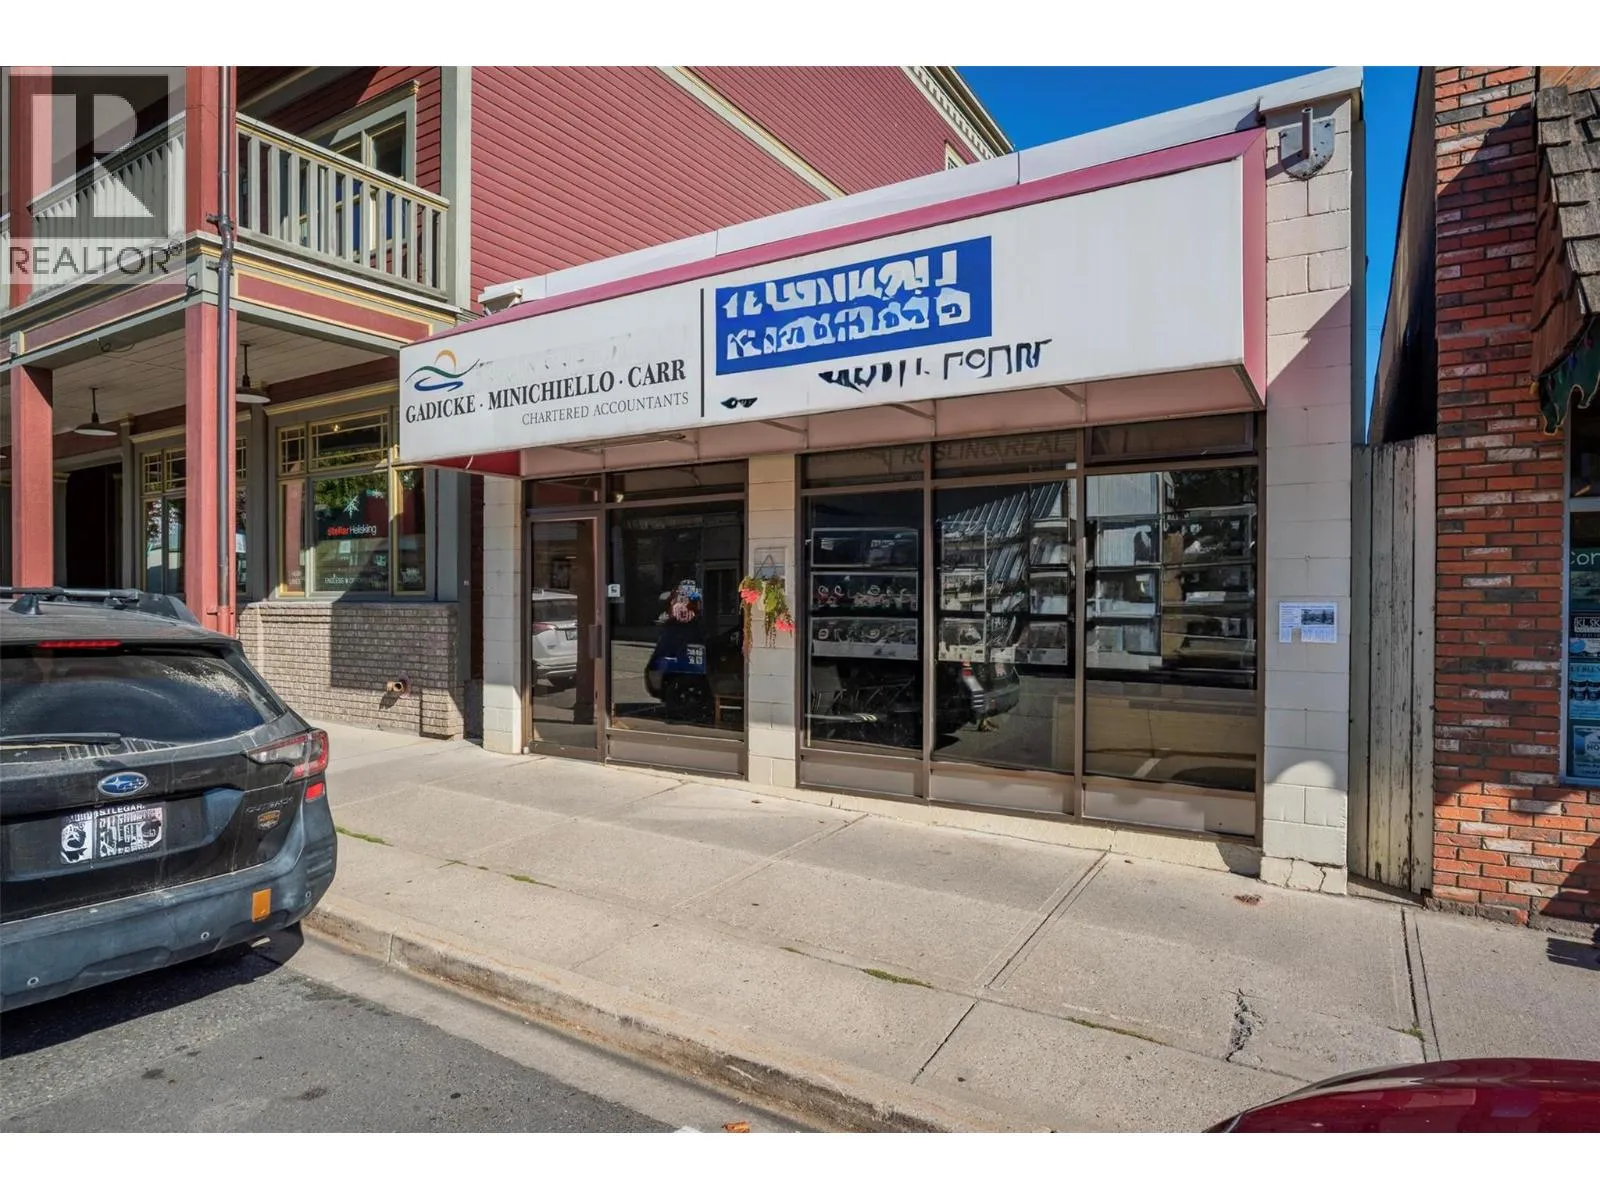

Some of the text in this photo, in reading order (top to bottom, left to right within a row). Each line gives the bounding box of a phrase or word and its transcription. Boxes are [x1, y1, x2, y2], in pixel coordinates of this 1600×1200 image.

[405, 358, 687, 424] GADICKE MINICHIELLO CARR
[521, 391, 689, 426] CHARTERED ACCOUNTANTS
